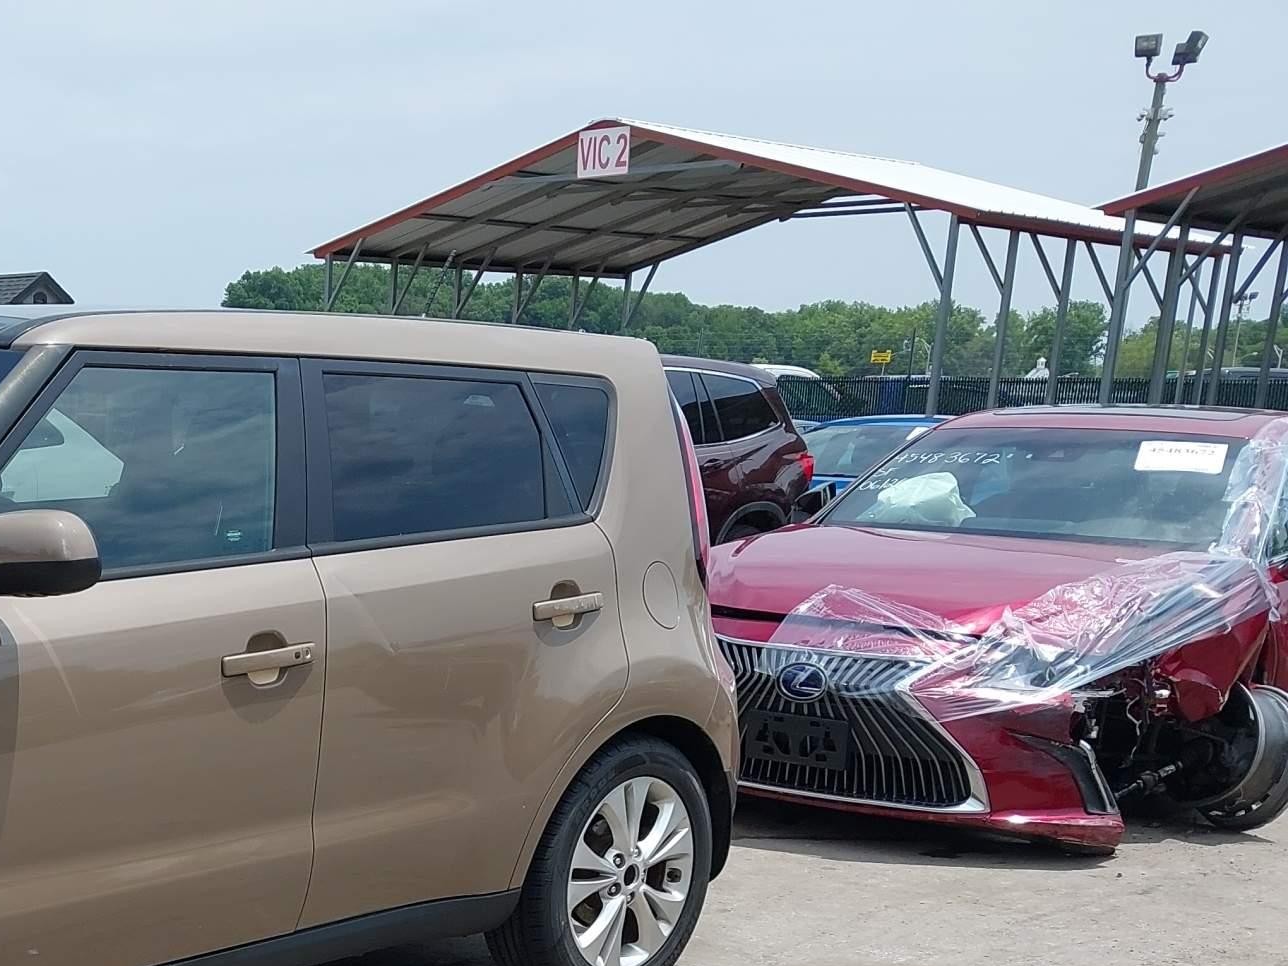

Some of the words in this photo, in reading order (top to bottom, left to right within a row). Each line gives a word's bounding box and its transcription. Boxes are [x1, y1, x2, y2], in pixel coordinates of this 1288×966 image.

[580, 134, 611, 170] VIC
[614, 133, 628, 168] 2
[895, 451, 1000, 464] 45483672
